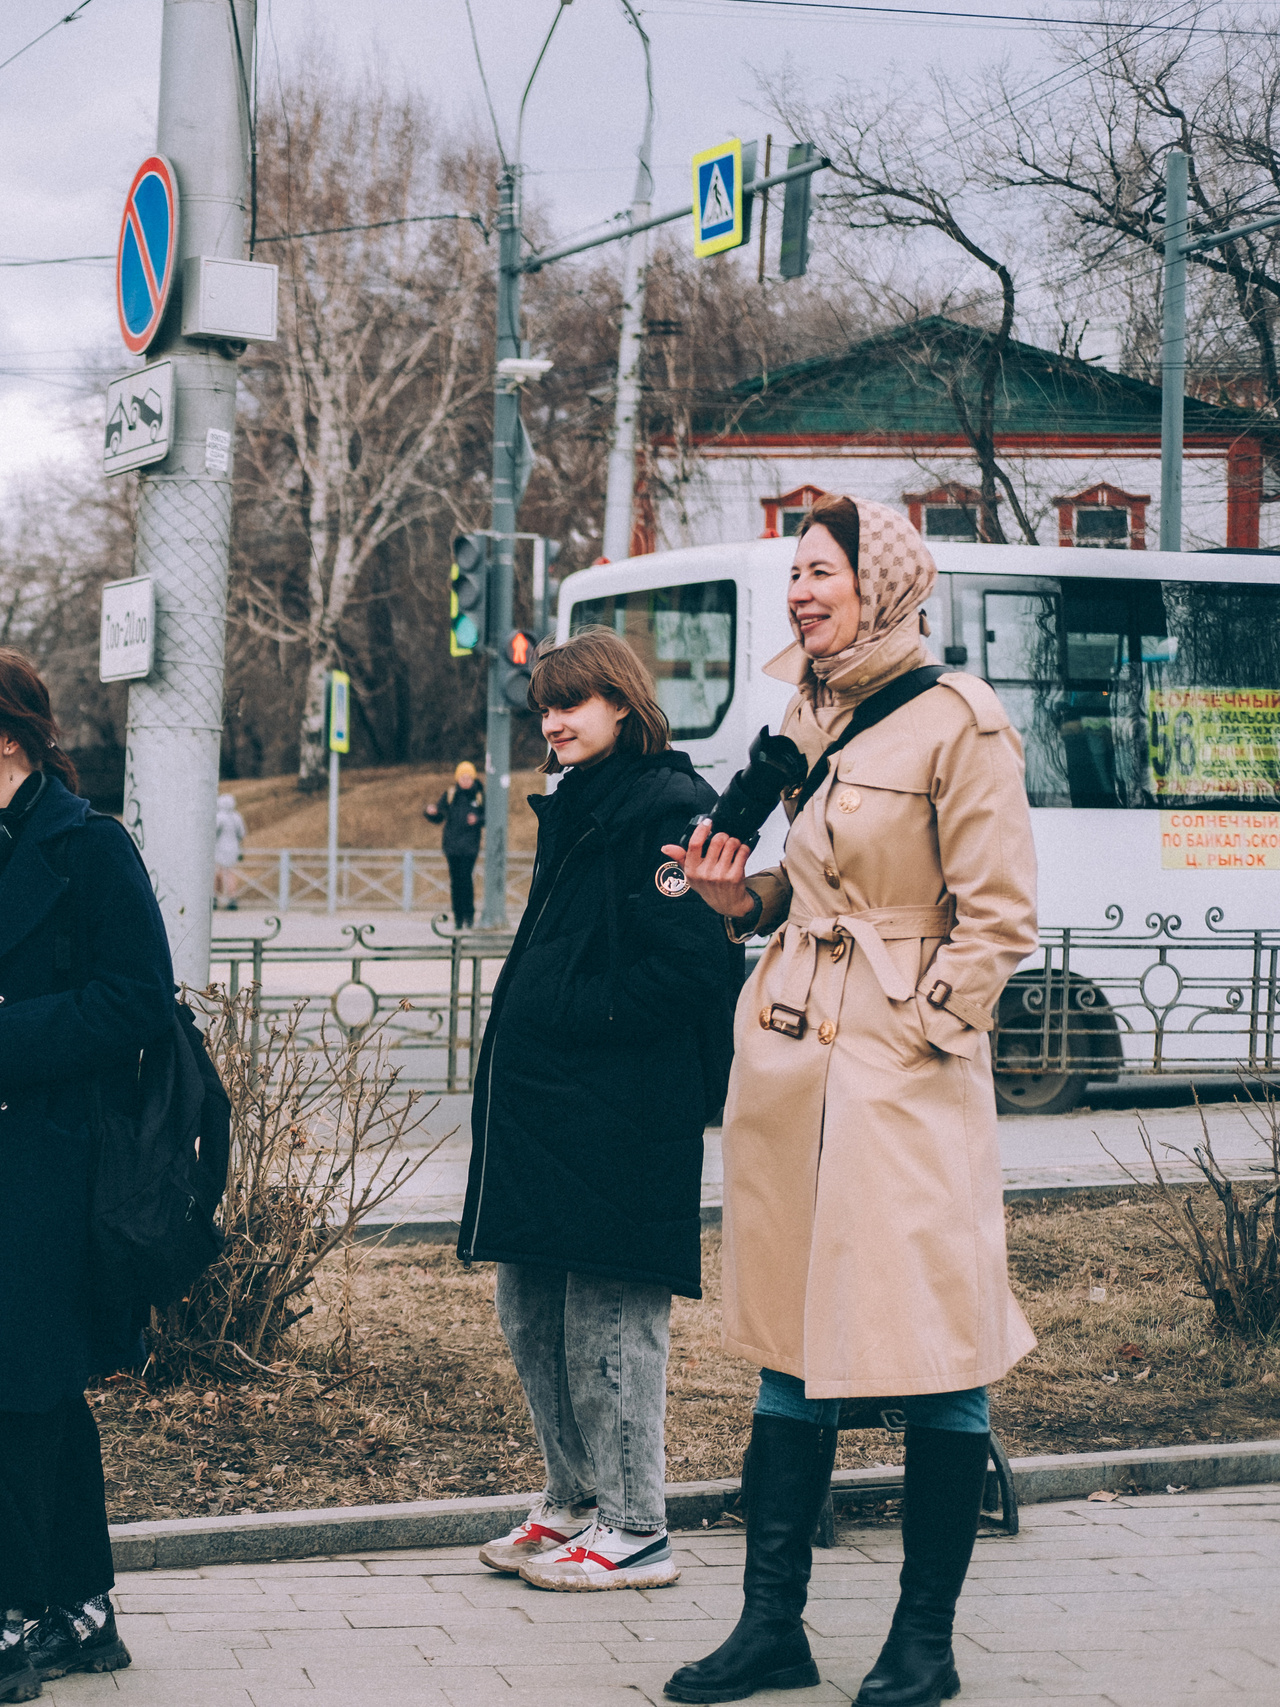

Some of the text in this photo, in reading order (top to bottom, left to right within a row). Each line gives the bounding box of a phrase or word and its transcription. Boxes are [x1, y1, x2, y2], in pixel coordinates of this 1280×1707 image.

[1151, 711, 1196, 776] 56
[1171, 813, 1279, 828] СОЛНЕЧНЫЙ
[1162, 833, 1280, 848] ПО БАЙКАЛЬСКО
[1208, 854, 1266, 867] РЫНОК
